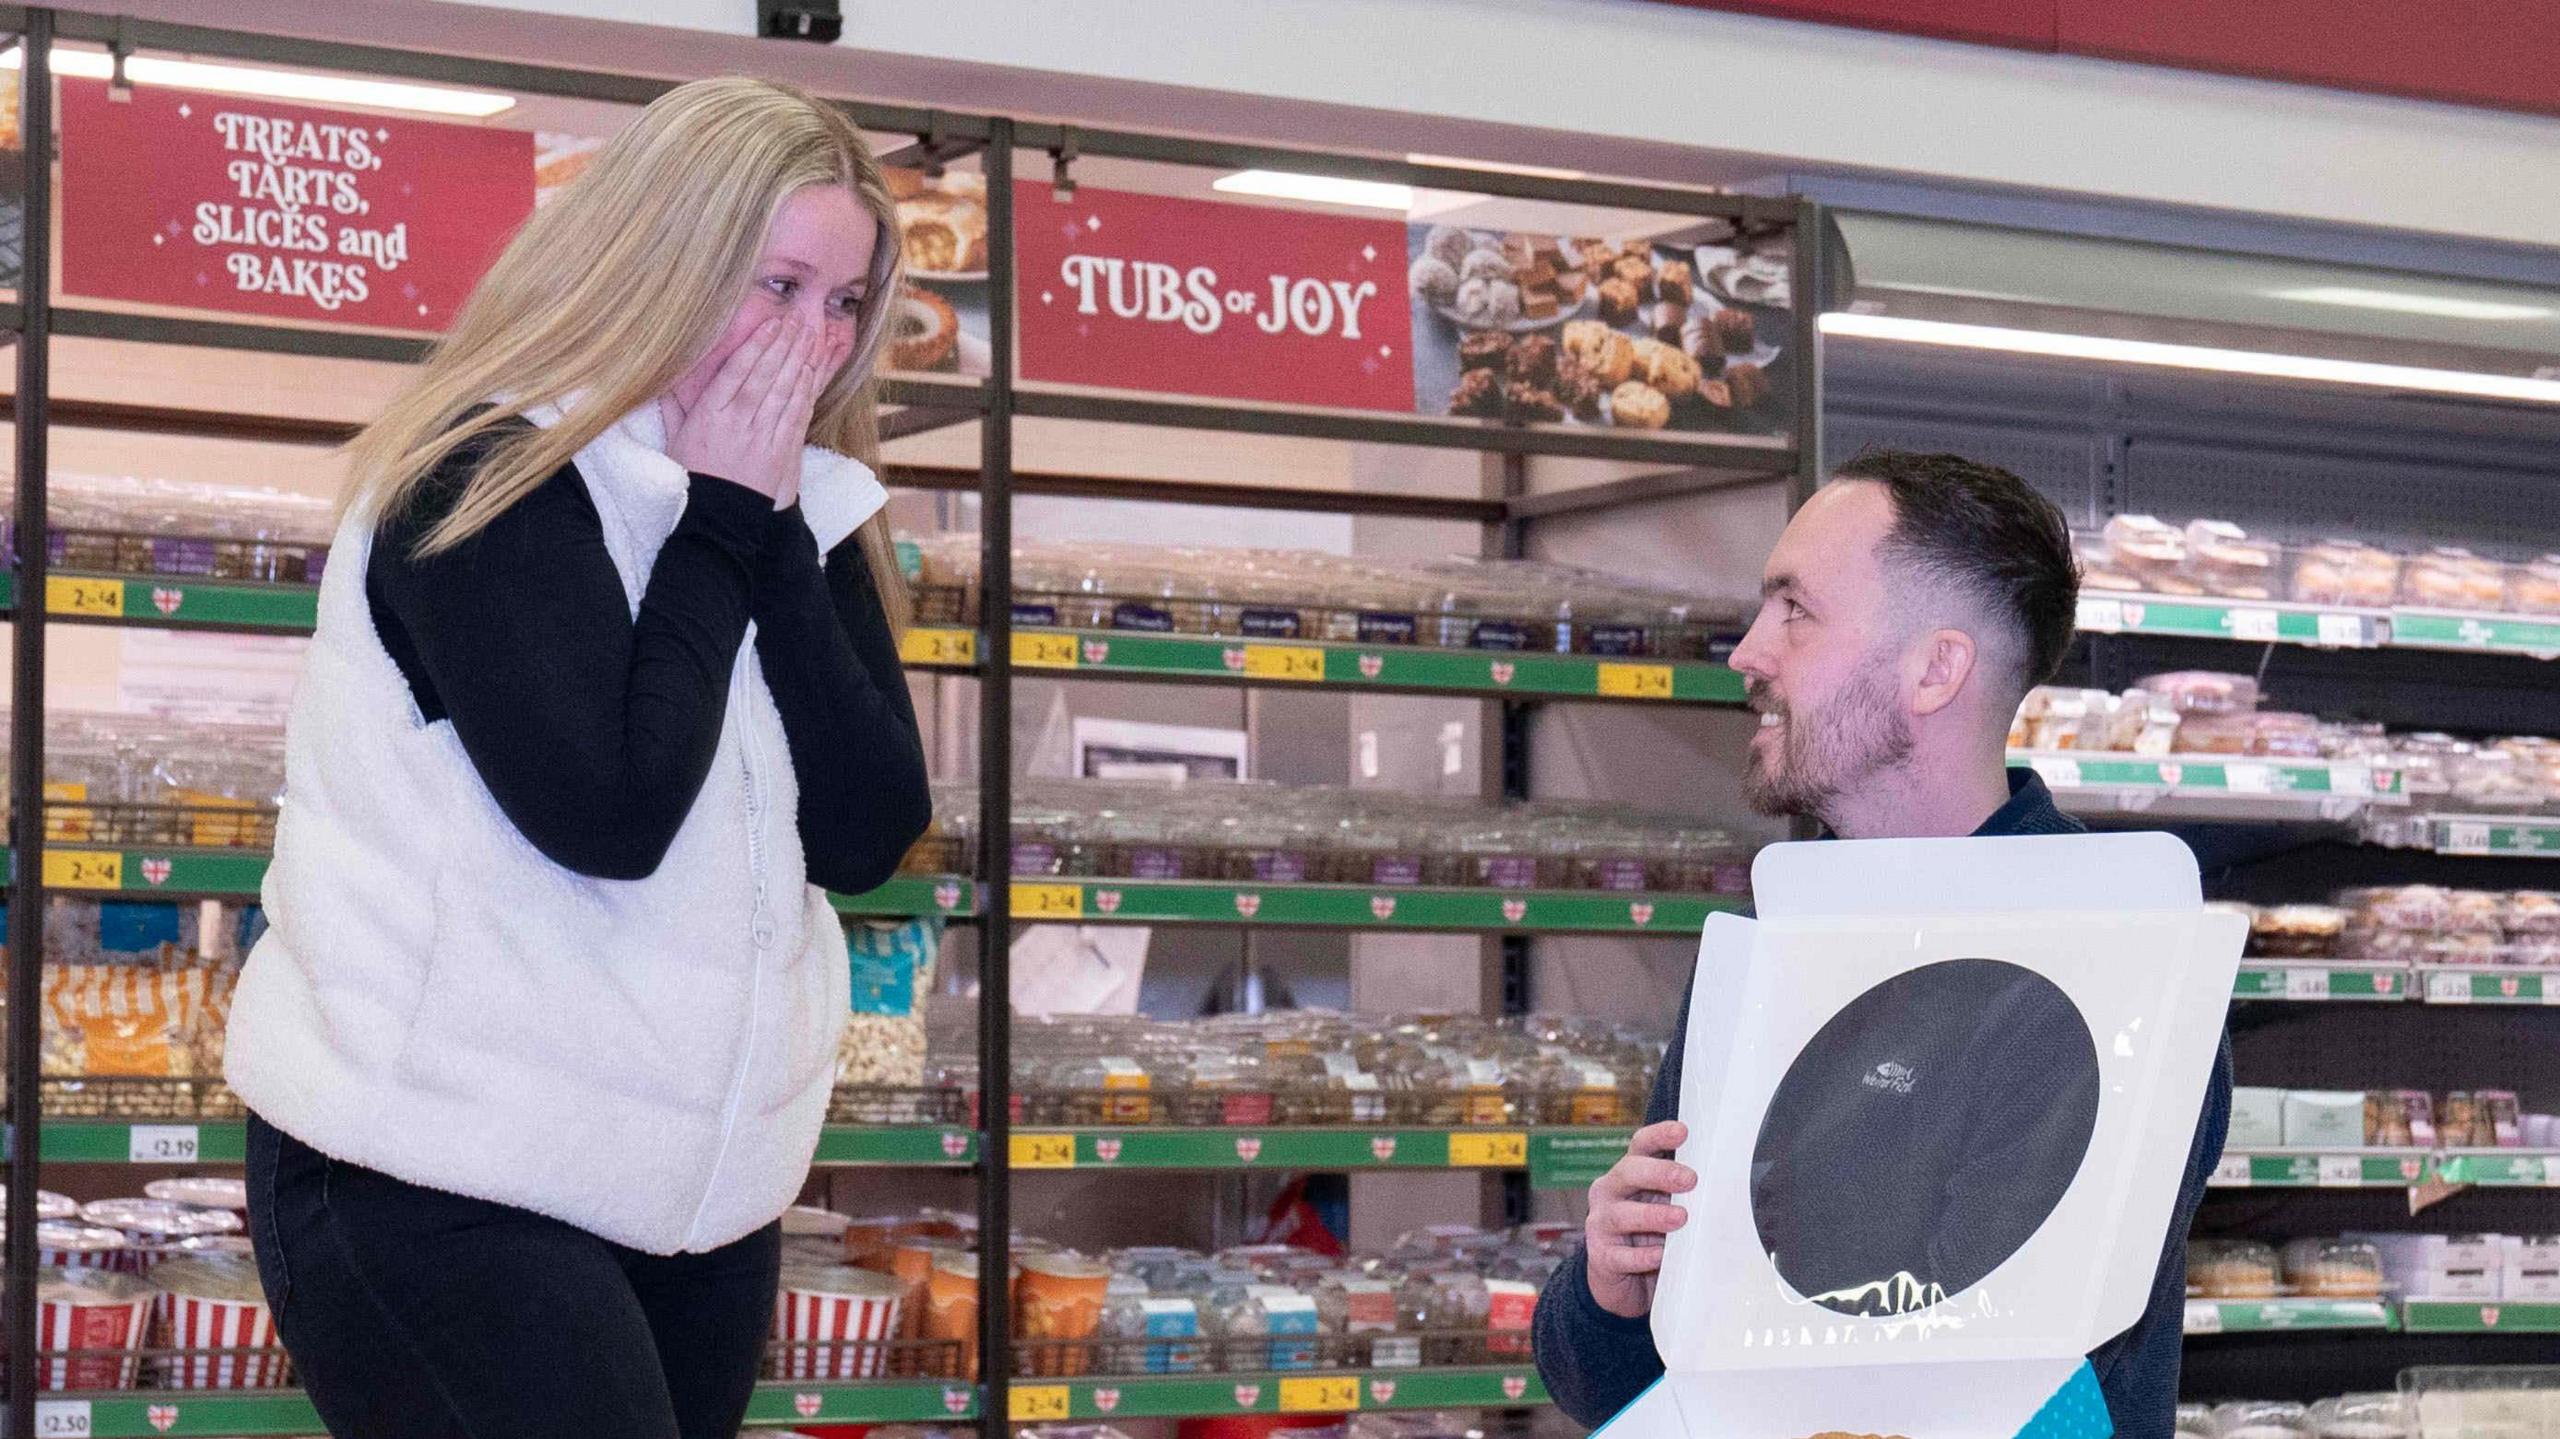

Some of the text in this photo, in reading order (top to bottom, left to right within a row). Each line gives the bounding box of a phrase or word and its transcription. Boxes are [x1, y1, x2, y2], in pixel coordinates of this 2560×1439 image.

[213, 112, 382, 171] TREATS,
[228, 159, 370, 215] TARTS,
[192, 201, 409, 271] SLICES and
[226, 251, 369, 310] BAKES
[1060, 254, 1223, 335] TUBS
[1256, 274, 1377, 339] JOY
